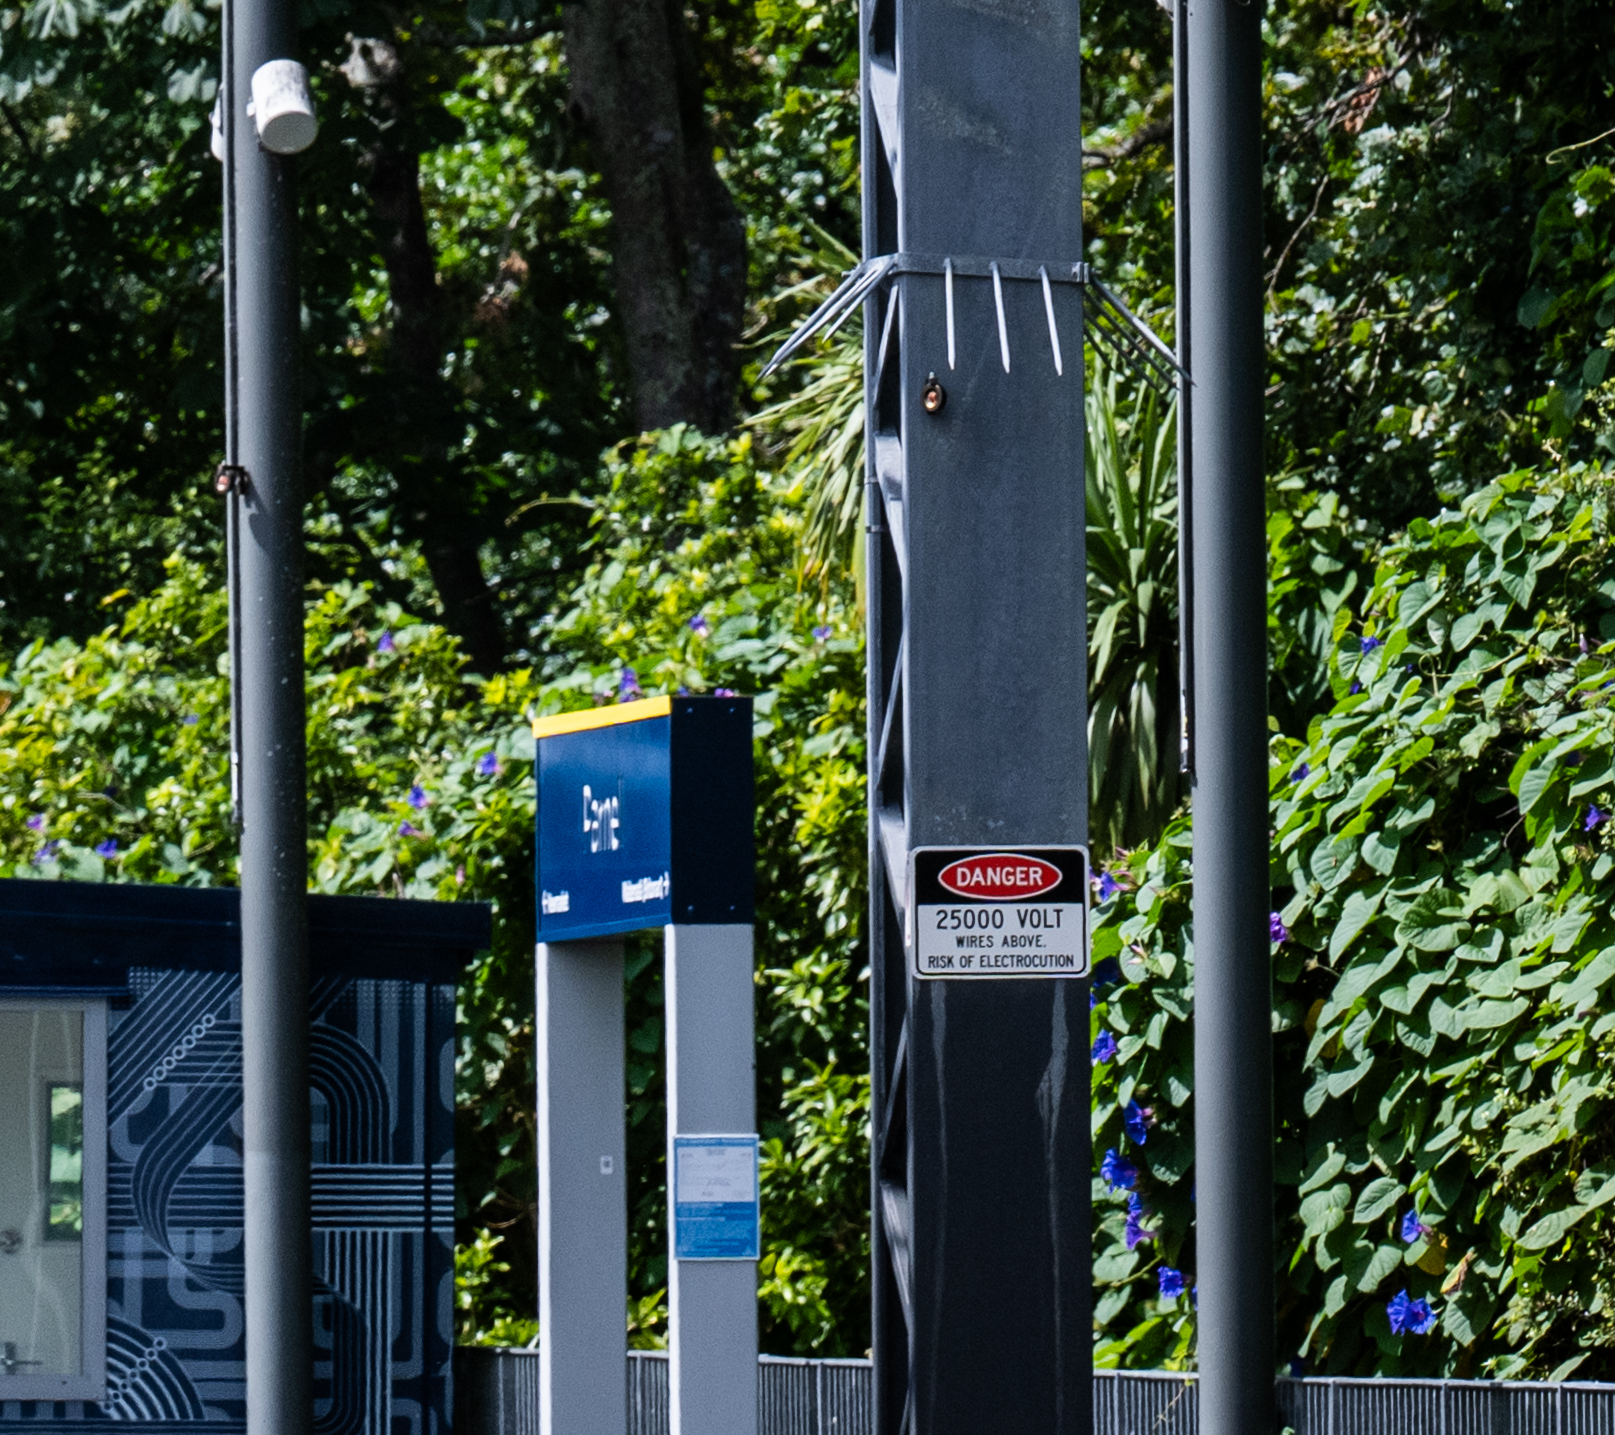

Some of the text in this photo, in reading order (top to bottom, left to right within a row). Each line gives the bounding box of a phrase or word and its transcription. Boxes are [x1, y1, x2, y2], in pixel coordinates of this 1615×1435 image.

[956, 866, 1043, 887] DANGER
[936, 908, 1063, 930] 25000 VOLT
[956, 935, 1046, 948] WIRES ABOVE.
[928, 954, 1074, 969] RISK OF ELECTROCUTION
